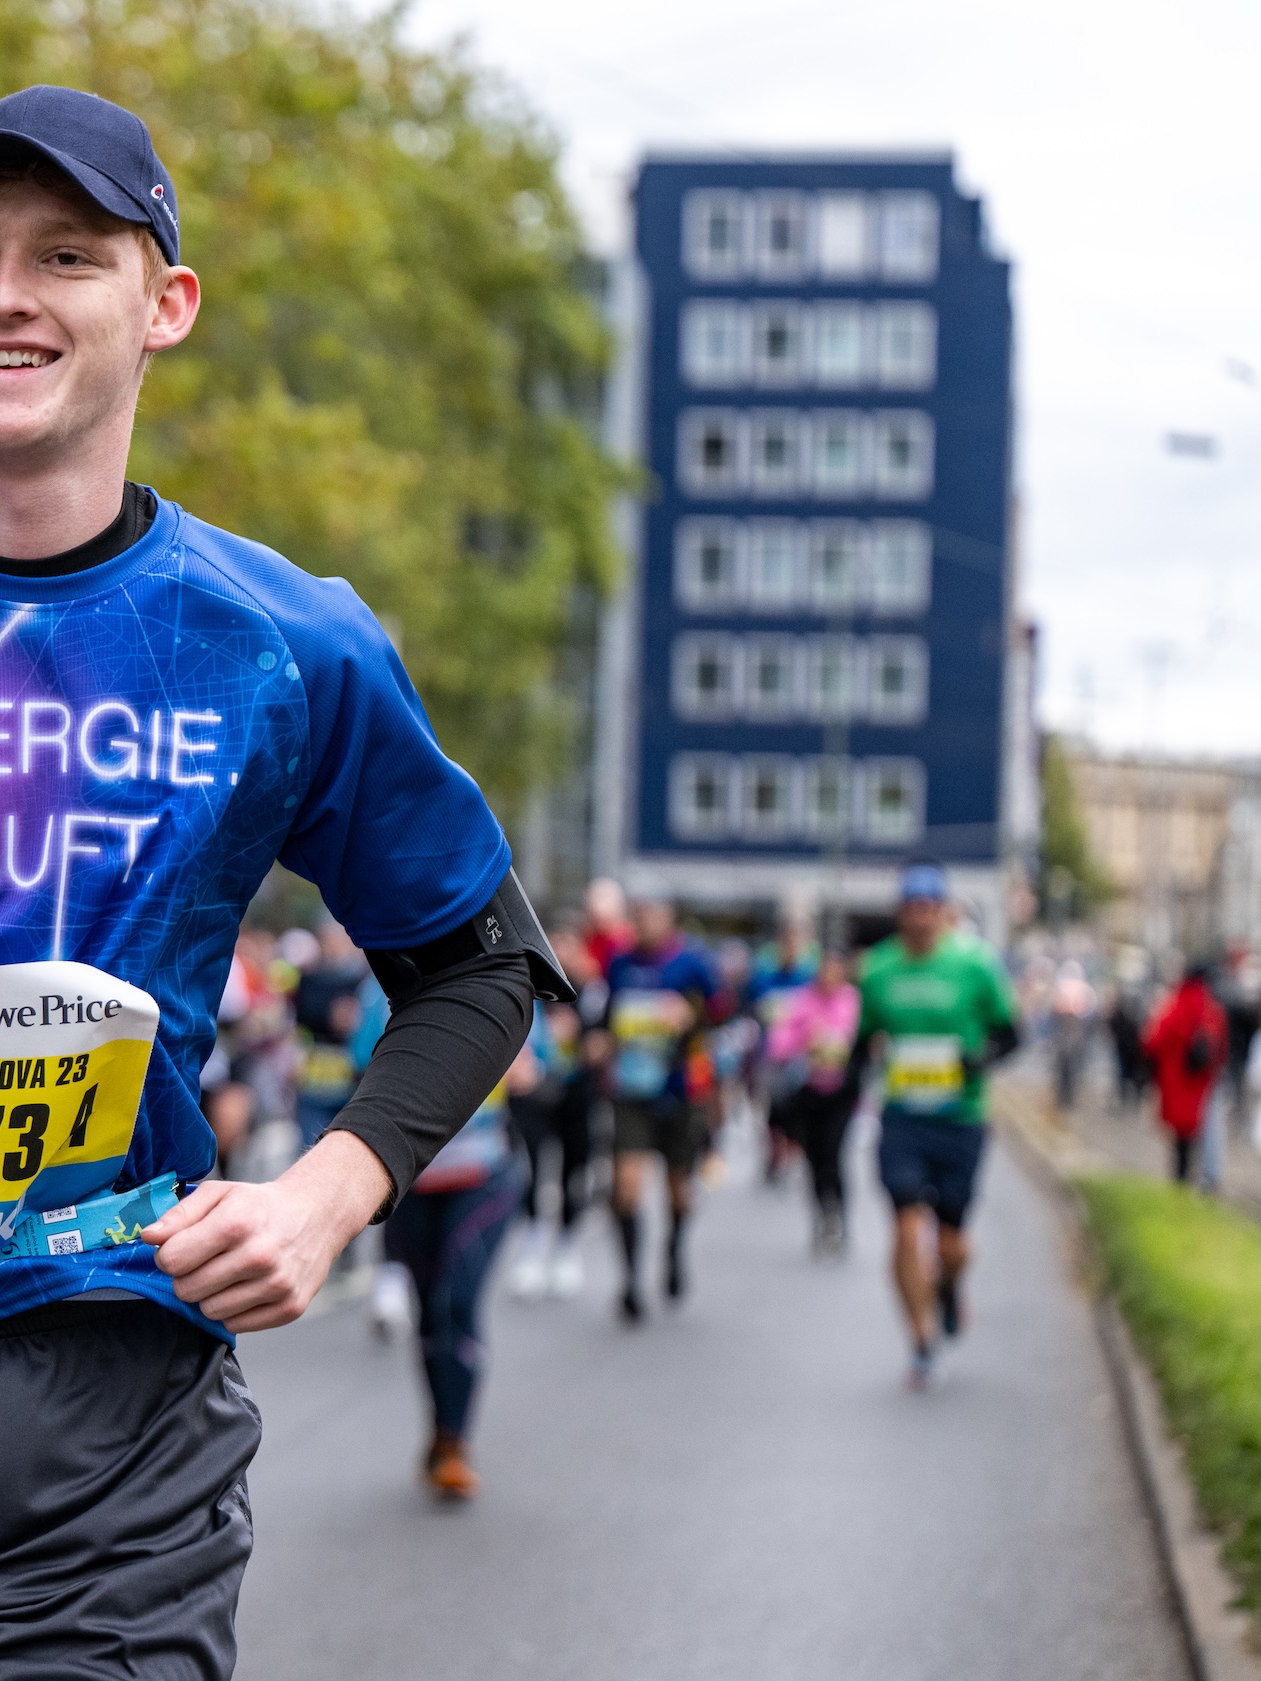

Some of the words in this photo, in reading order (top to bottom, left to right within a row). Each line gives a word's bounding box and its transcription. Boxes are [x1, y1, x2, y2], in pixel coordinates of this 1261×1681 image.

[39, 994, 123, 1027] Price
[55, 1053, 90, 1087] 23
[69, 1082, 99, 1148] A
